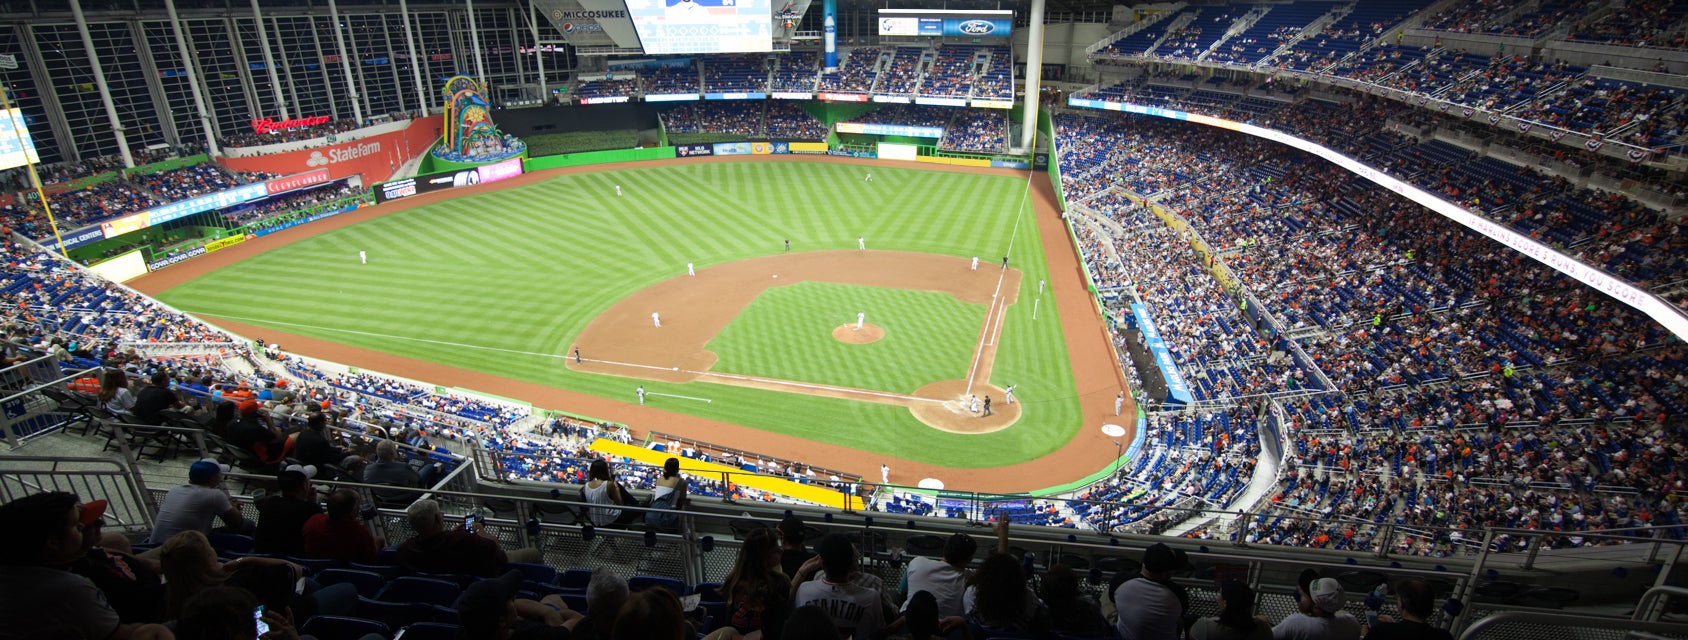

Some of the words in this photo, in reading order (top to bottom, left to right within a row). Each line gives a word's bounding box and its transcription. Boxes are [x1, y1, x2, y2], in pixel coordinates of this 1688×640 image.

[563, 10, 626, 19] MICCOSUKEE
[965, 22, 988, 33] Ford
[251, 115, 330, 134] Budweiser
[268, 173, 328, 192] CLEVELANDER
[54, 237, 79, 249] MDICAL
[79, 230, 103, 242] CENTERS
[1477, 222, 1511, 243] MARLINS
[1511, 236, 1541, 257] SCORE
[1583, 270, 1604, 287] YOU
[1606, 281, 1647, 306] SCORE
